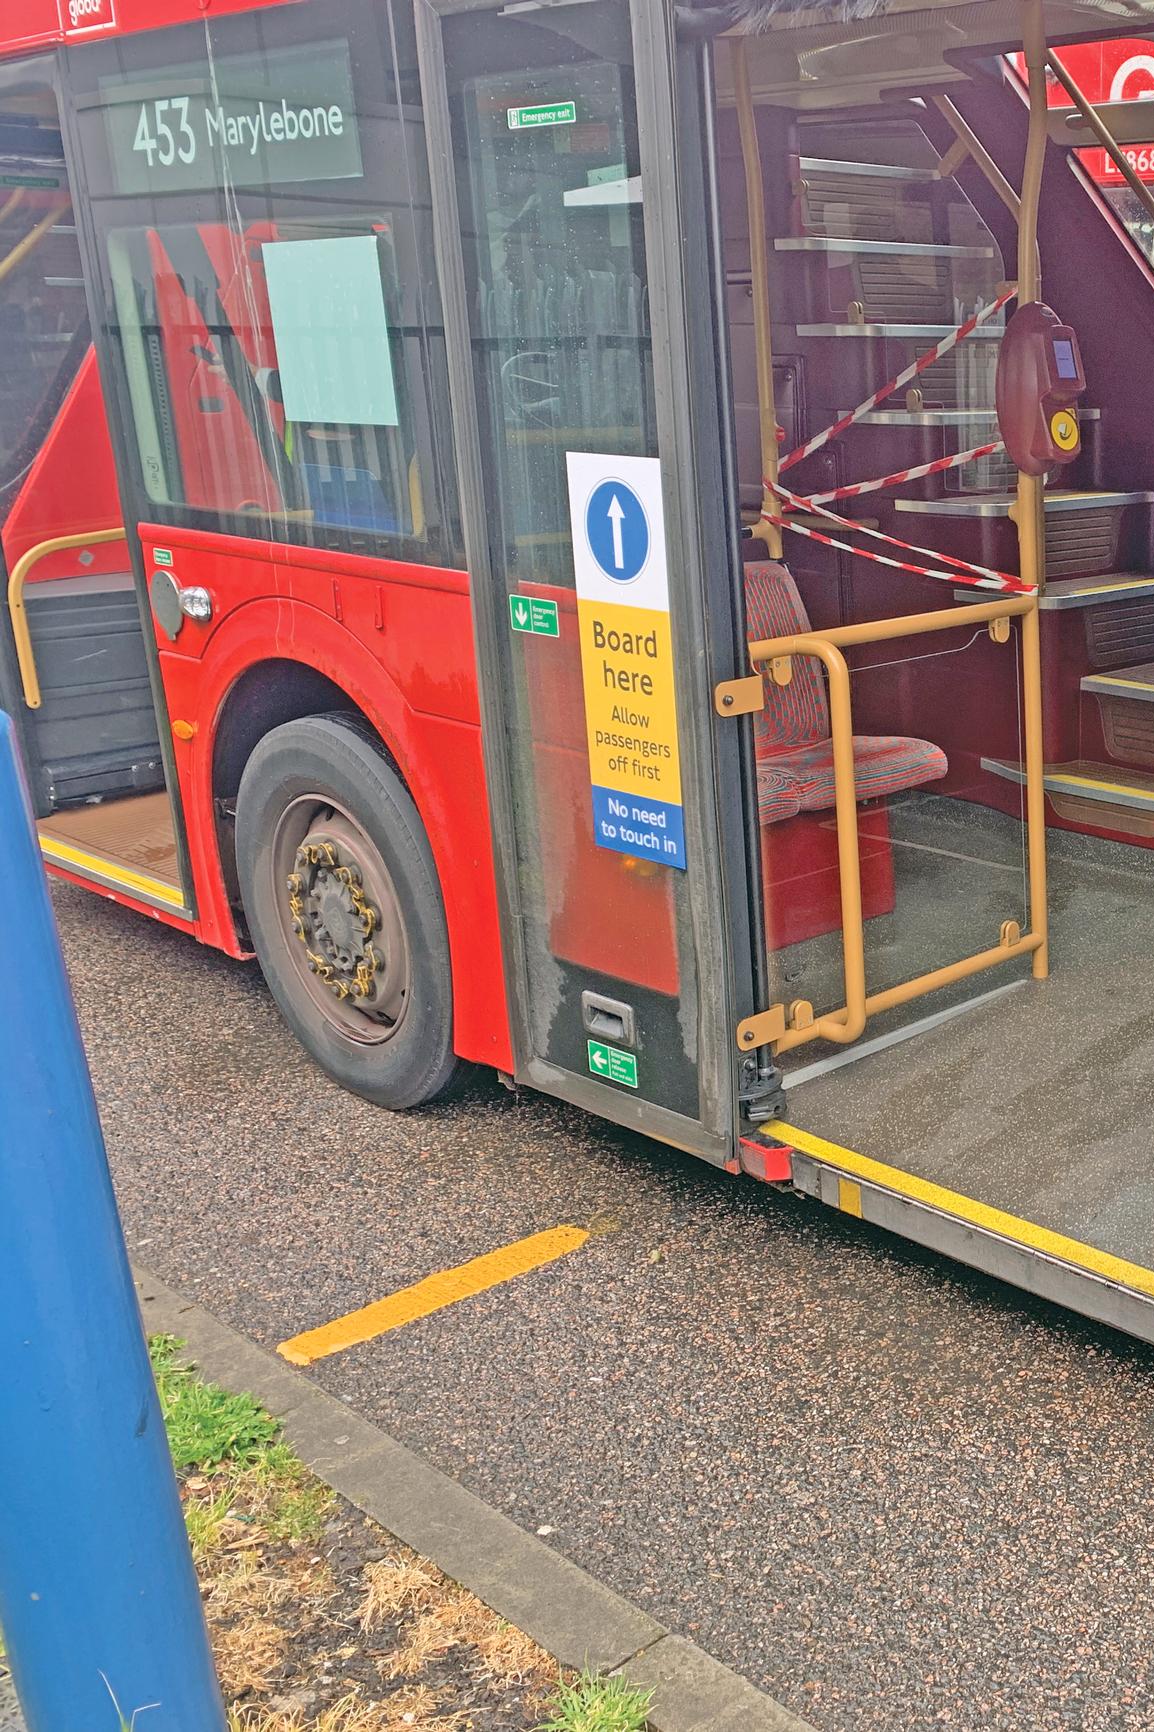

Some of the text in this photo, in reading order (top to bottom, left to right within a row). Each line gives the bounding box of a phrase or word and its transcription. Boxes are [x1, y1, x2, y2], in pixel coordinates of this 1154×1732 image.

[522, 108, 571, 123] Emergency exit
[133, 97, 344, 167] 453 Marylebone
[593, 620, 658, 659] Board
[603, 660, 653, 696] here
[611, 705, 650, 729] Allow
[595, 730, 671, 759] passengers
[608, 755, 661, 782] off first
[608, 798, 667, 829] No need
[601, 820, 677, 855] to touch in
